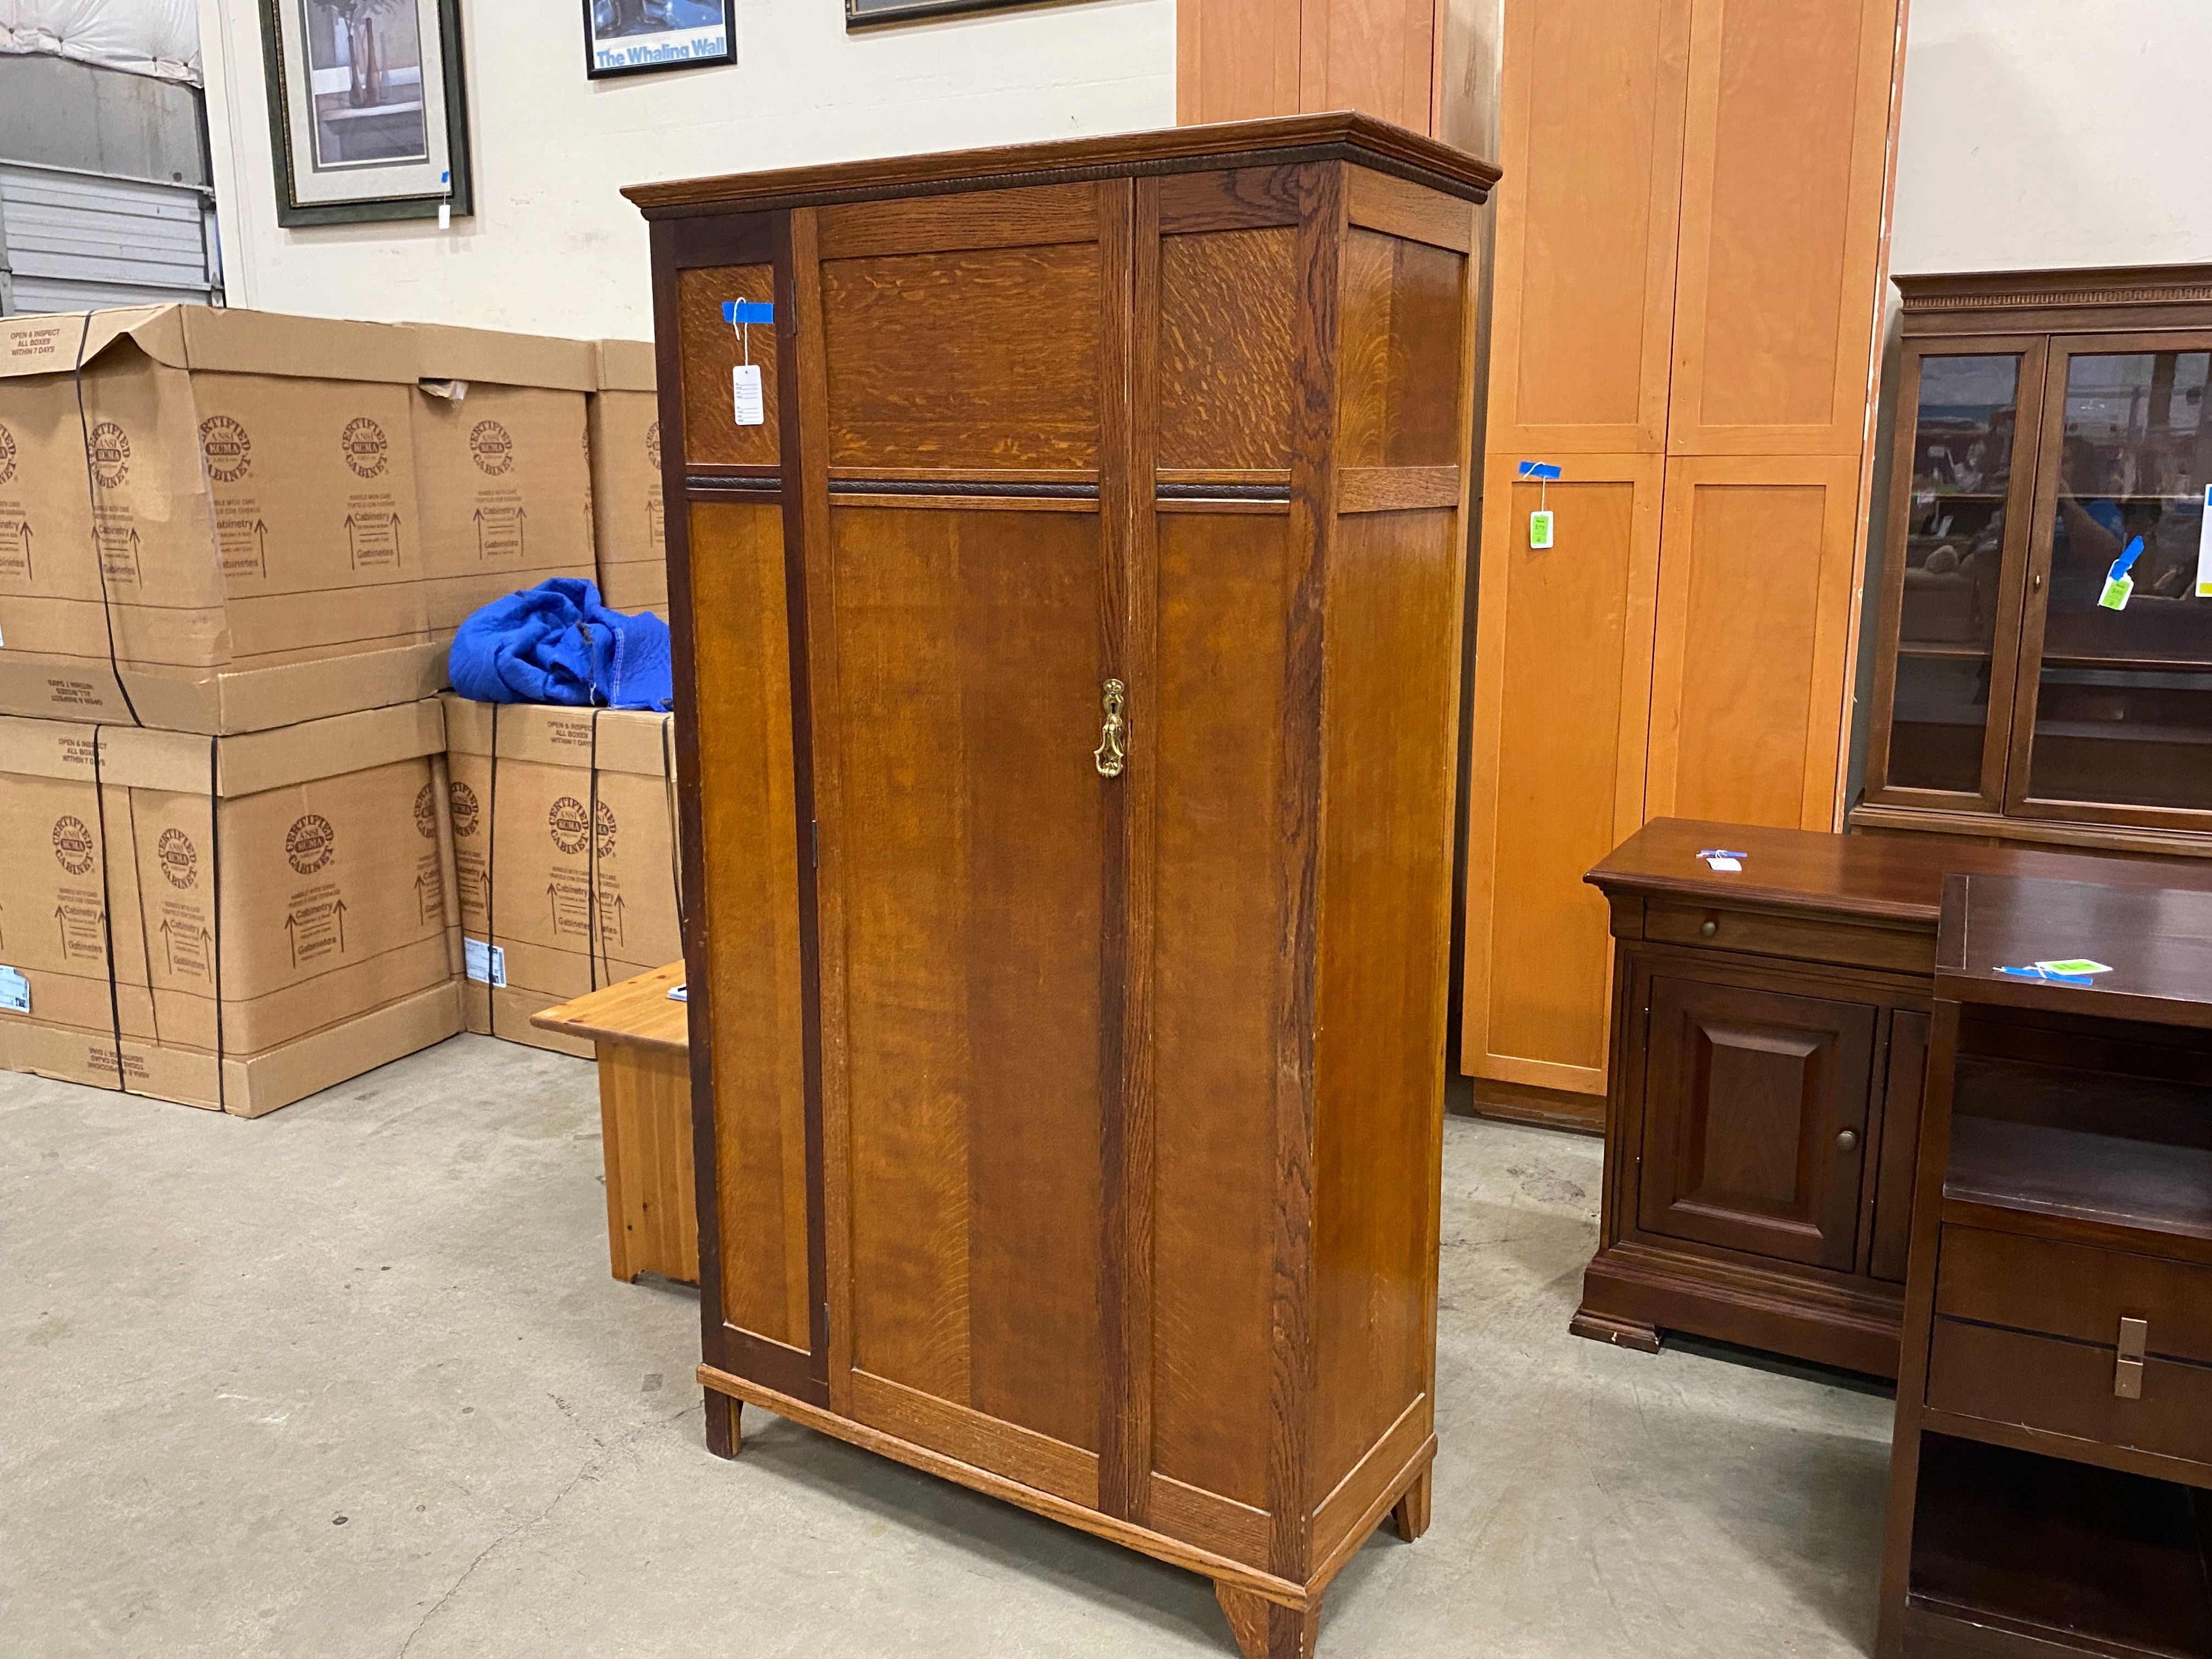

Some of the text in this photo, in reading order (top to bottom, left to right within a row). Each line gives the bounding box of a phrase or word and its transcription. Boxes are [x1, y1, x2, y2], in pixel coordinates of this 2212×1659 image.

[597, 37, 725, 67] The Whaling Wall
[11, 347, 32, 356] WITHIN
[30, 338, 50, 346] BOXES
[200, 416, 251, 451] RTIFIED
[342, 417, 387, 450] CERTIFIED
[470, 420, 512, 450] CERTIFIED
[208, 443, 240, 454] KCMA
[206, 455, 251, 482] ABINET
[346, 454, 387, 478] CABINET
[473, 454, 512, 476] CABINET
[571, 723, 592, 731] INSPEC
[58, 738, 75, 746] OPEN
[62, 755, 83, 764] WITHIN
[549, 797, 589, 830] CERTIFIED
[53, 815, 93, 849] CERTIFIED
[286, 815, 334, 853] CERTIFIED
[551, 830, 588, 854] CABINET
[158, 828, 196, 864] CERTIFIED
[55, 849, 93, 875] CABINET
[289, 845, 334, 874] CABINET
[161, 861, 197, 889] CABINET
[556, 883, 588, 898] Cabinetry
